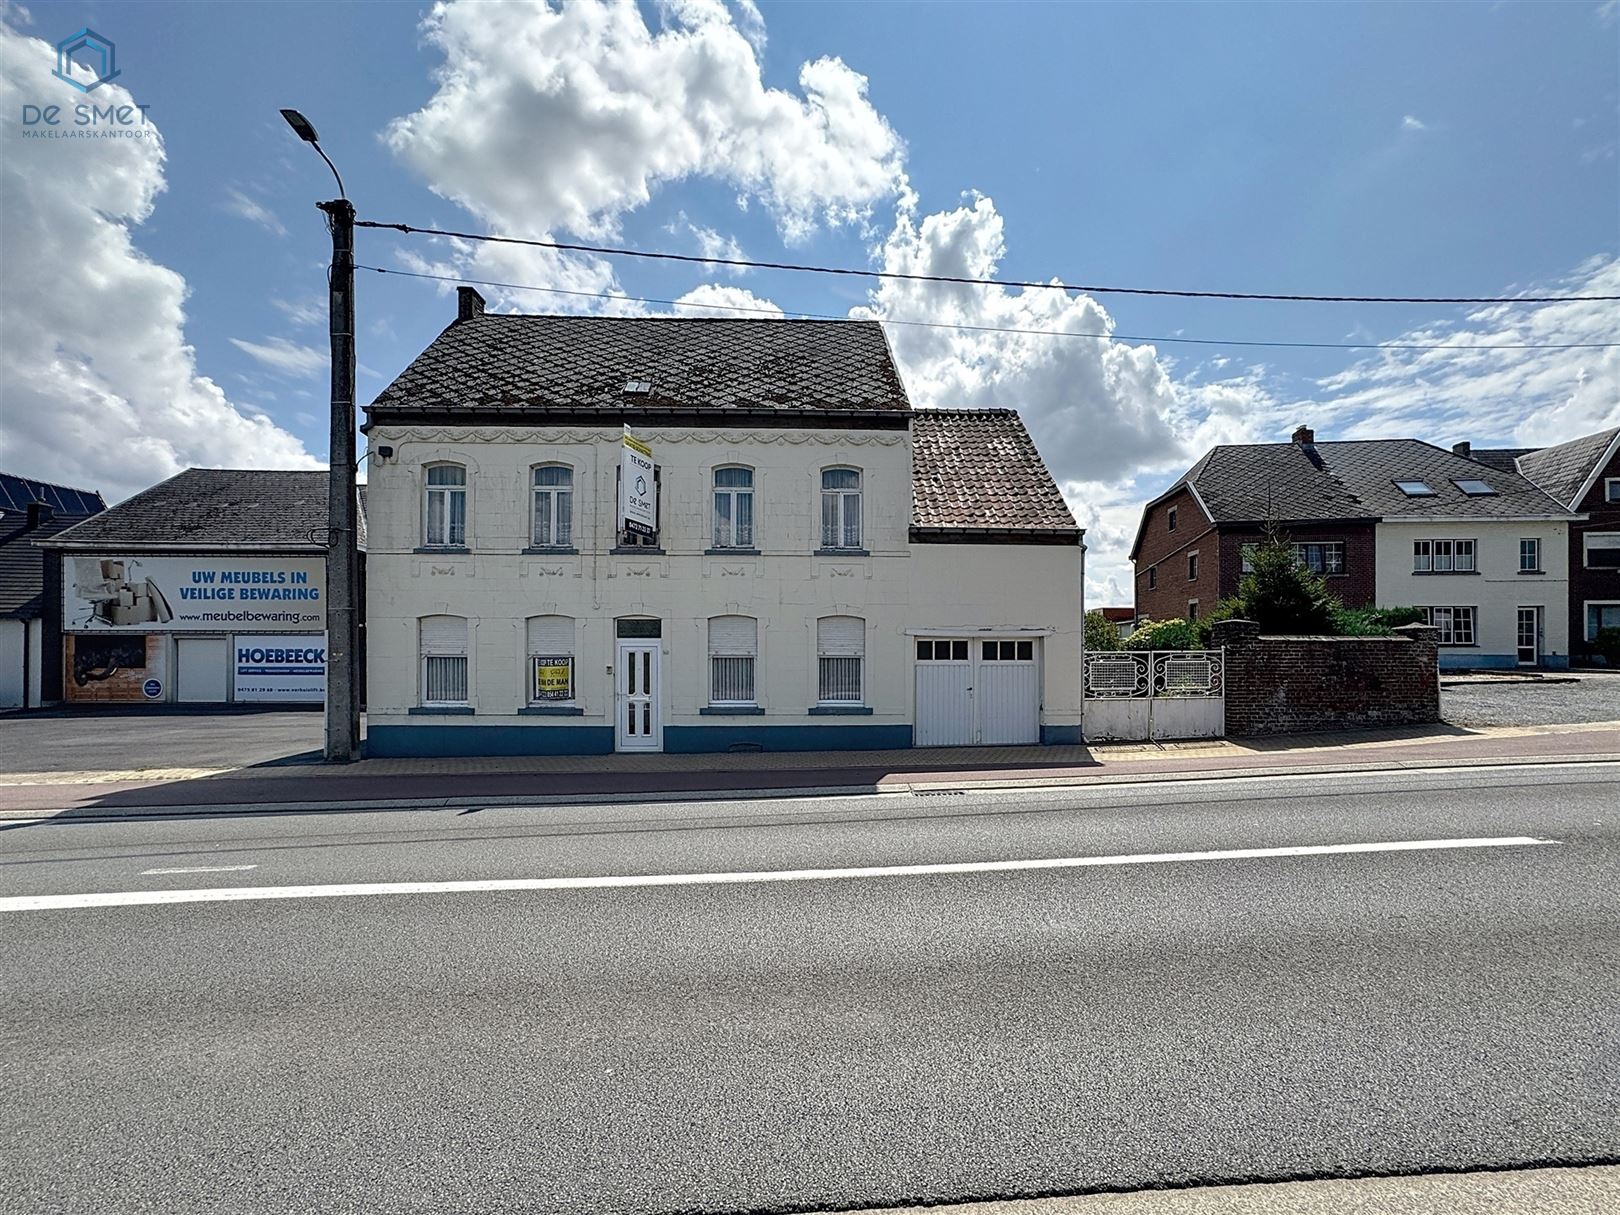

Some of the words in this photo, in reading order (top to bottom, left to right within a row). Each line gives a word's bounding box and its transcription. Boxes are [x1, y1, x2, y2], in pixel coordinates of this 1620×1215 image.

[638, 459, 652, 470] KOOP
[192, 571, 216, 584] UW
[221, 571, 286, 584] MEUBELS
[291, 571, 307, 584] IN
[180, 588, 235, 600] VEILIGE
[240, 588, 319, 600] BEWARING
[180, 611, 320, 624] www.meubelbewaring.com
[238, 648, 325, 664] HOEBEECK
